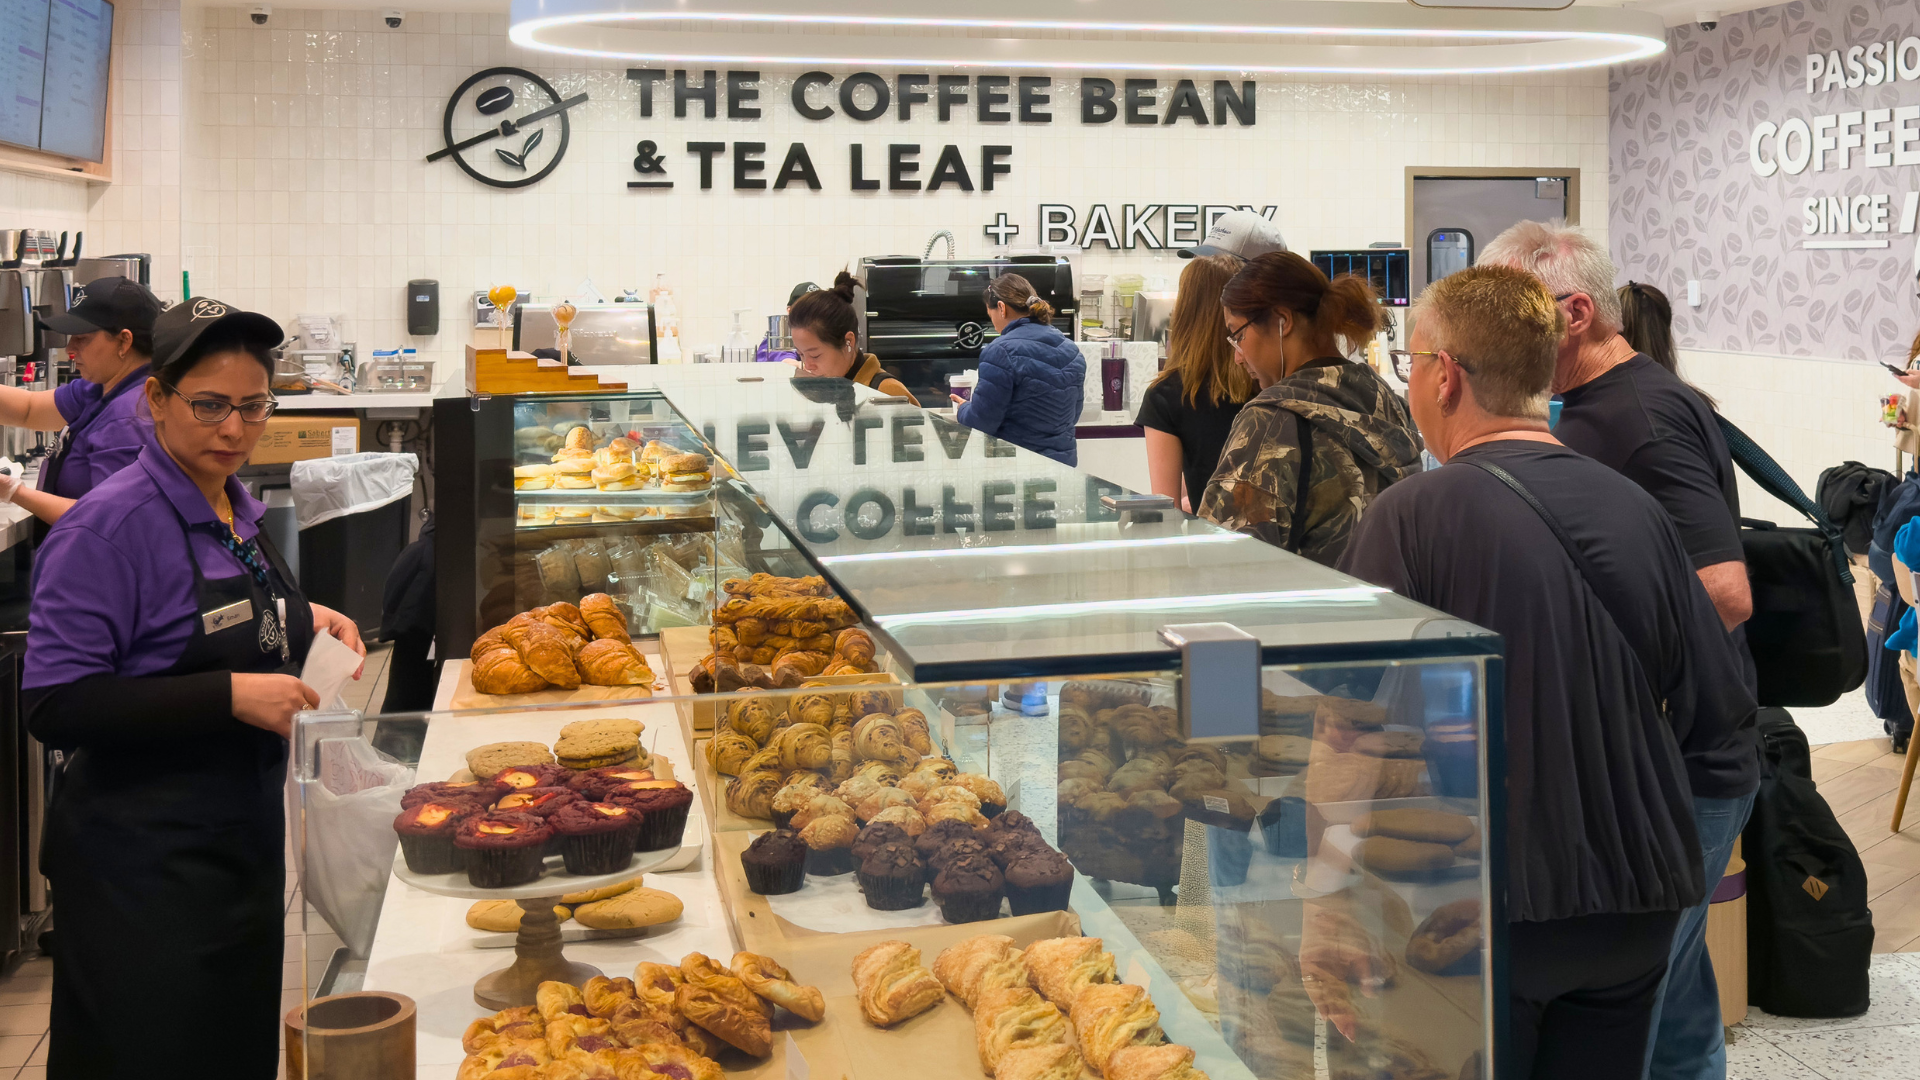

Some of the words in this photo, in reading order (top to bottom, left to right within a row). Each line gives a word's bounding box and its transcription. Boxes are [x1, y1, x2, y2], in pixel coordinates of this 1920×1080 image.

[1806, 36, 1920, 94] PASSIO
[626, 68, 762, 119] THE
[791, 70, 1052, 123] COFFEE
[1080, 77, 1256, 126] BEAN
[632, 139, 667, 174] &
[686, 141, 823, 191] TEA
[850, 143, 1013, 192] LEAF
[1749, 105, 1920, 178] COFFEE
[1802, 193, 1890, 236] SINCE
